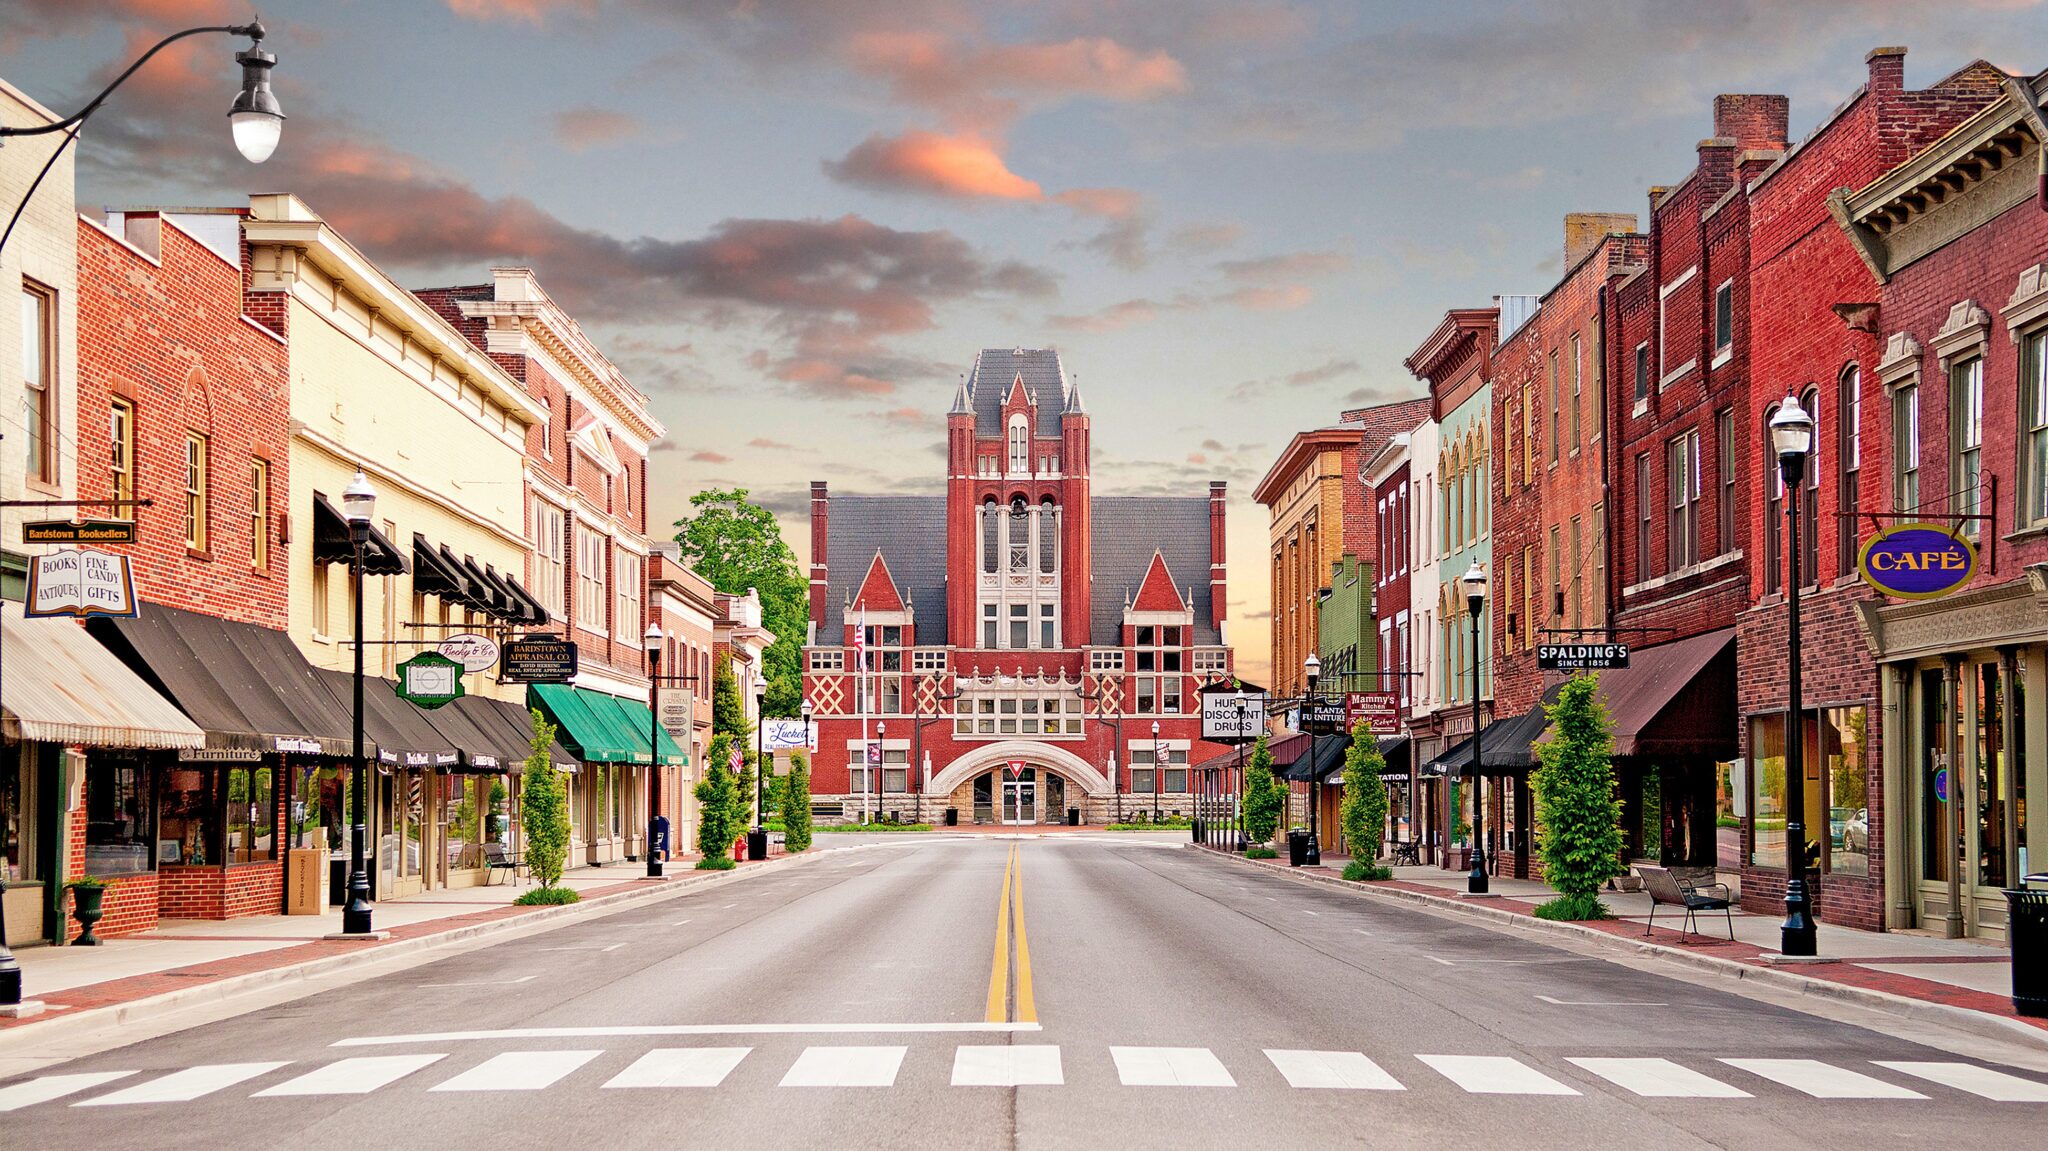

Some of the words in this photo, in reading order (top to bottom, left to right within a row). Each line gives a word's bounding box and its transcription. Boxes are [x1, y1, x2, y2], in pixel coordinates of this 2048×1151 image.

[28, 529, 74, 539] Bardstown
[78, 529, 128, 539] Booksellers
[1871, 545, 1965, 571] CAFÉ
[42, 557, 78, 574] BOOKS
[86, 557, 109, 571] FINE
[87, 568, 120, 584] CANDY
[38, 583, 79, 601] ANTIQUES
[87, 586, 120, 603] GIFTS
[514, 645, 566, 653] BARDSTOWN
[1540, 645, 1627, 659] SPALDING'S
[509, 653, 553, 661] APPRAISAL
[1557, 659, 1584, 667] SINCE
[1588, 659, 1610, 667] 1856
[1214, 698, 1249, 708] HURT
[1351, 694, 1395, 705] Mammy's
[1204, 710, 1261, 720] DISCOUNT
[1314, 706, 1346, 714] PLANTA
[1214, 721, 1253, 731] DRUGS
[192, 749, 257, 760] Furniture
[1377, 773, 1409, 781] TATION
